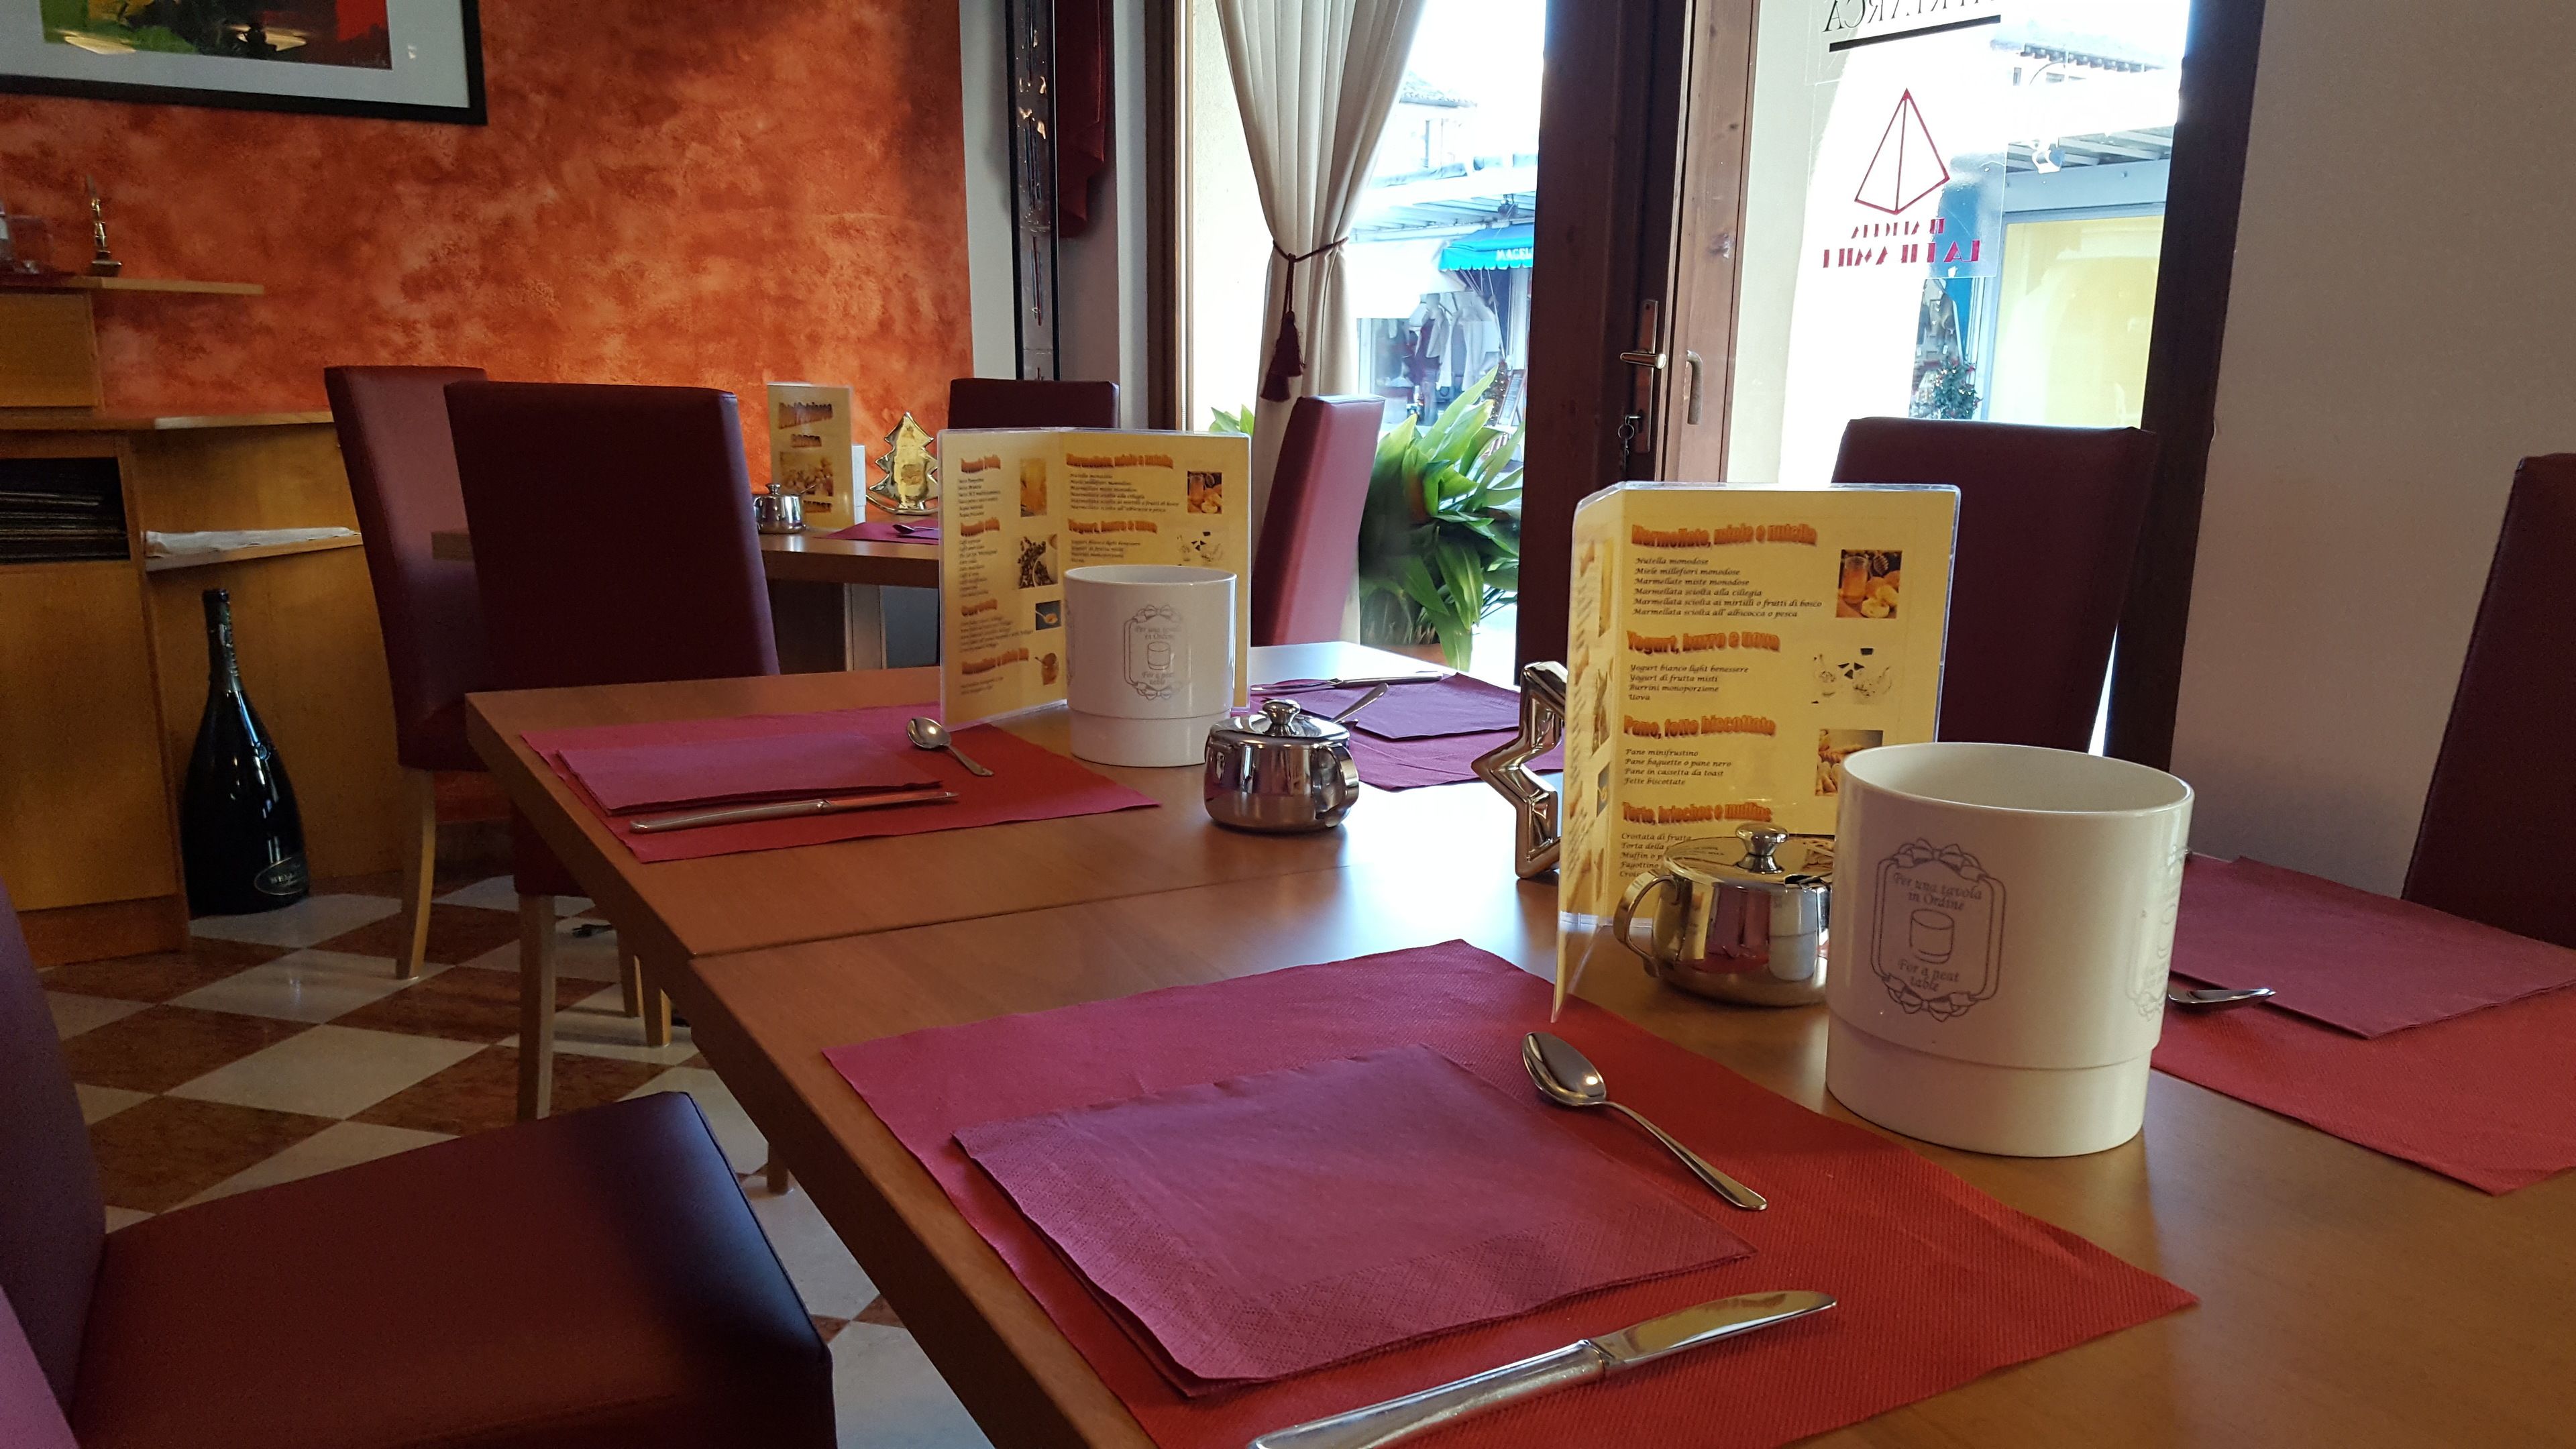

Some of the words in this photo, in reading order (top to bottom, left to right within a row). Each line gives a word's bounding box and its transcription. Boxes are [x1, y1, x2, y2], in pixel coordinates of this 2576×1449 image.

[1756, 525, 1766, 543] e
[1660, 567, 1697, 576] millefiori
[1634, 588, 1682, 596] Marmellata
[1714, 588, 1729, 596] alla
[1762, 599, 1786, 609] frutti
[1789, 599, 1798, 607] di
[1800, 600, 1823, 608] bosco
[1633, 608, 1681, 616] Marmellata
[1774, 610, 1797, 619] pesca
[1728, 631, 1739, 648] e
[1630, 664, 1658, 673] Yogurt
[1689, 665, 1708, 674] light
[1629, 674, 1657, 683] Yogurt
[1669, 675, 1695, 683] frutta
[1662, 686, 1719, 694] monoporzione
[1648, 759, 1682, 767] baguette
[1715, 804, 1723, 820] e
[1620, 861, 1659, 869] Fagottino
[1894, 872, 1912, 886] Per
[1915, 879, 1937, 893] una
[1941, 884, 1982, 900] tavola
[1909, 892, 1919, 902] in
[1924, 893, 1965, 911] Ordine
[1898, 959, 1919, 973] For
[1921, 967, 1928, 977] a
[1910, 976, 1939, 992] table
